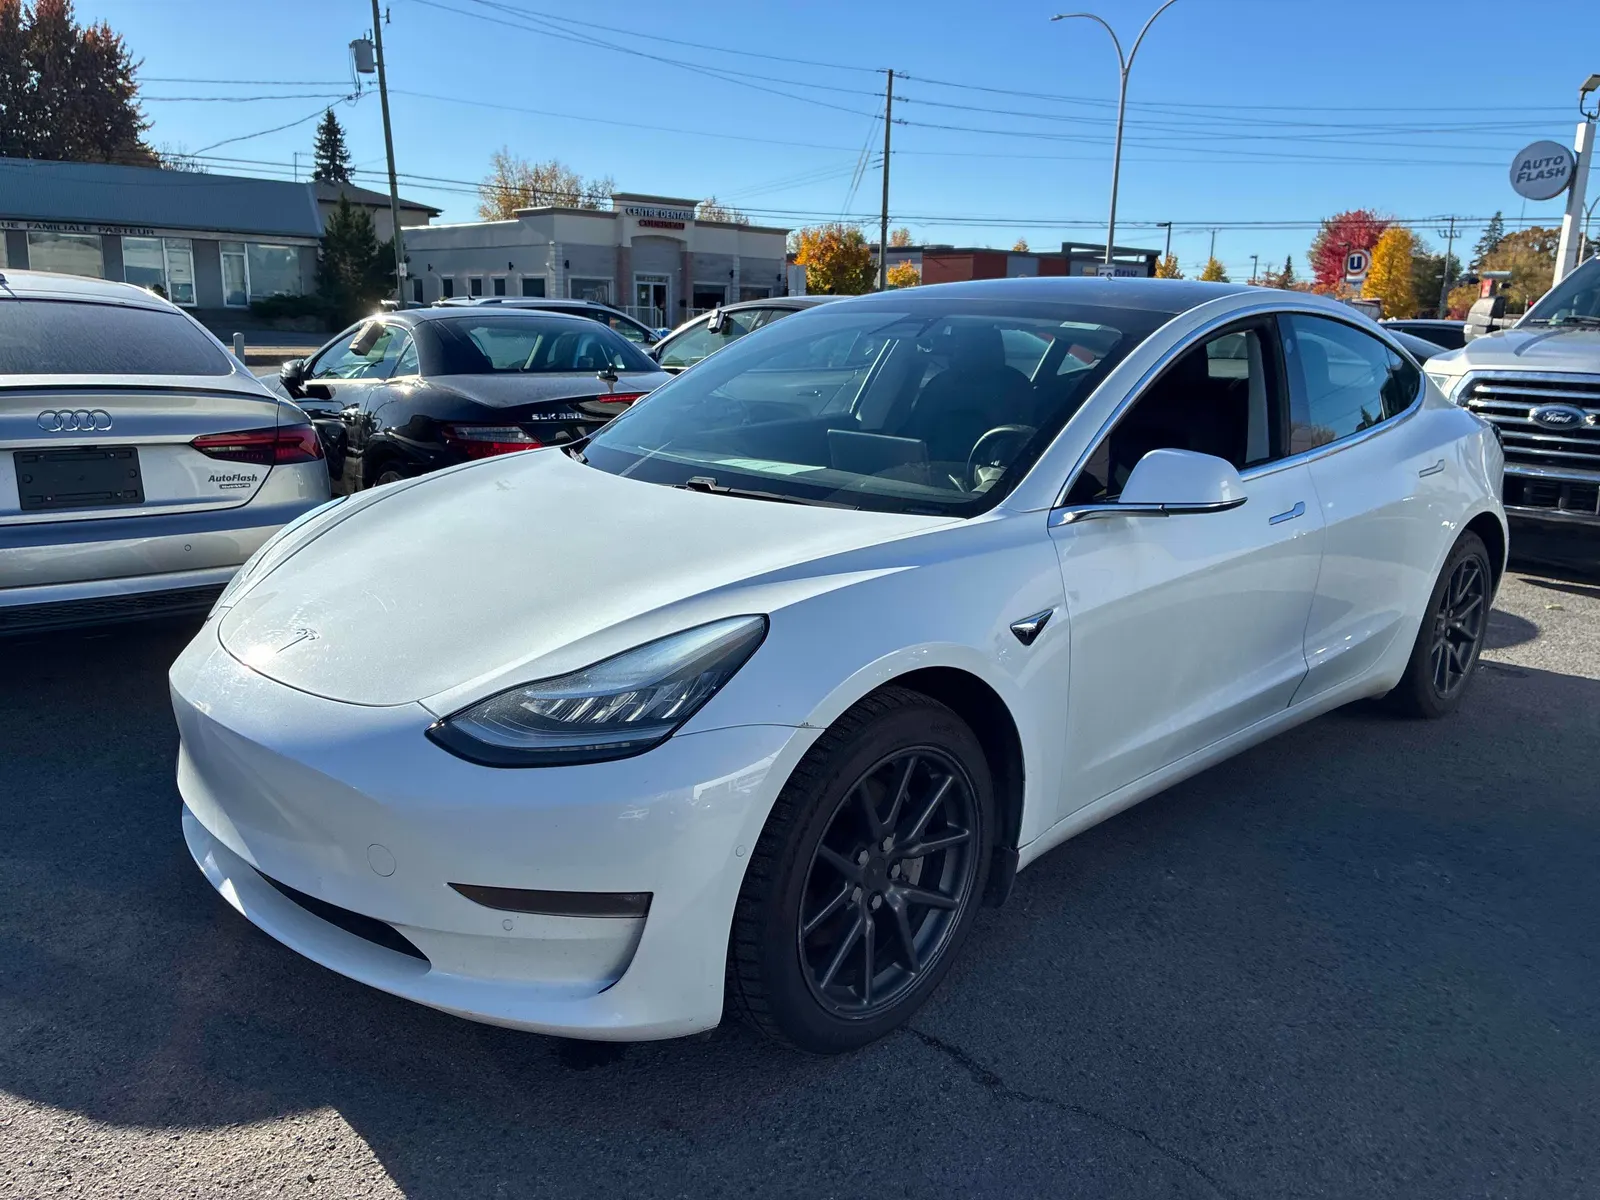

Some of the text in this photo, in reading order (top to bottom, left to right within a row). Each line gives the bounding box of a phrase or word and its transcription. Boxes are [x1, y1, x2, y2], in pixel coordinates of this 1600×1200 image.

[1519, 155, 1565, 172] AUTO
[1515, 166, 1567, 184] FLASH
[625, 207, 660, 217] CENTRE
[26, 222, 92, 233] FAMILIALE
[98, 227, 155, 236] PASTEUR
[1350, 256, 1362, 270] U
[1543, 411, 1572, 423] Ford
[208, 474, 257, 483] AutoFlash
